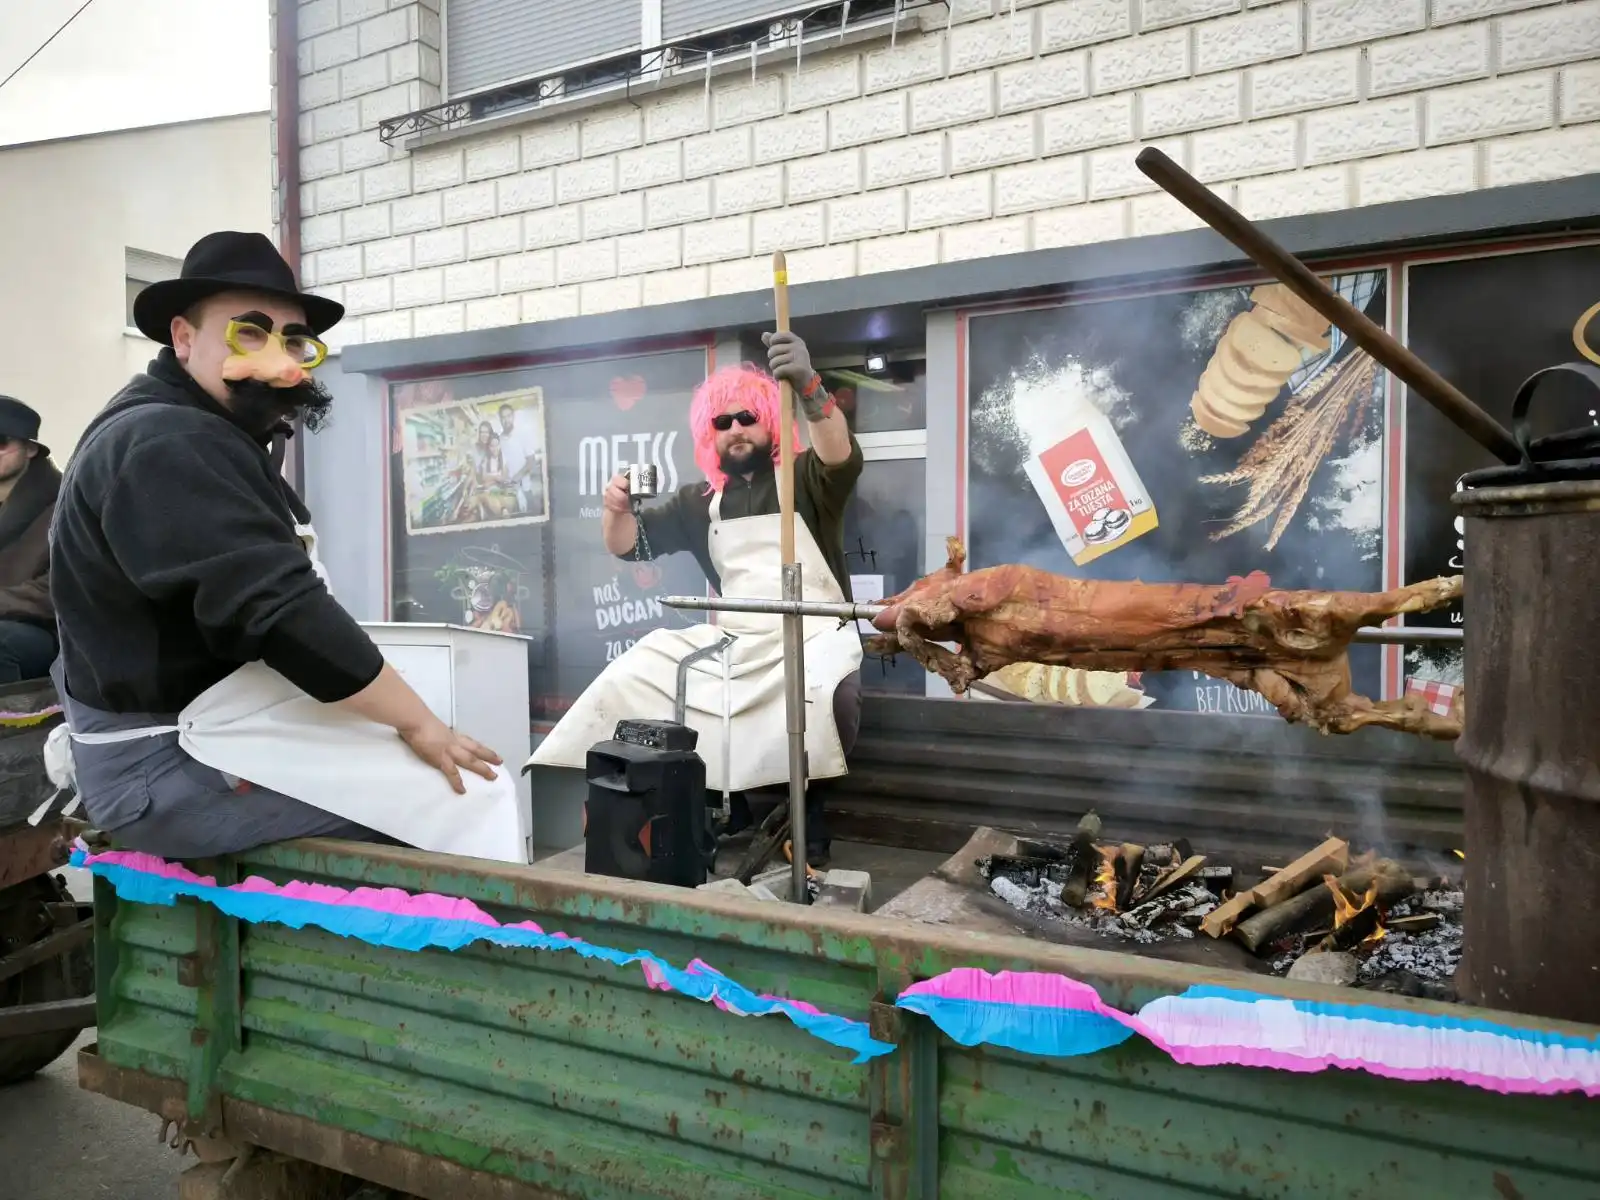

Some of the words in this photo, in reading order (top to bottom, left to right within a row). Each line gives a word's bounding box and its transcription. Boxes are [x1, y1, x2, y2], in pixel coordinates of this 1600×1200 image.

[1068, 498, 1081, 512] ZA
[593, 576, 621, 605] naš
[595, 595, 663, 630] DUĆAN
[1195, 684, 1223, 713] BEZ
